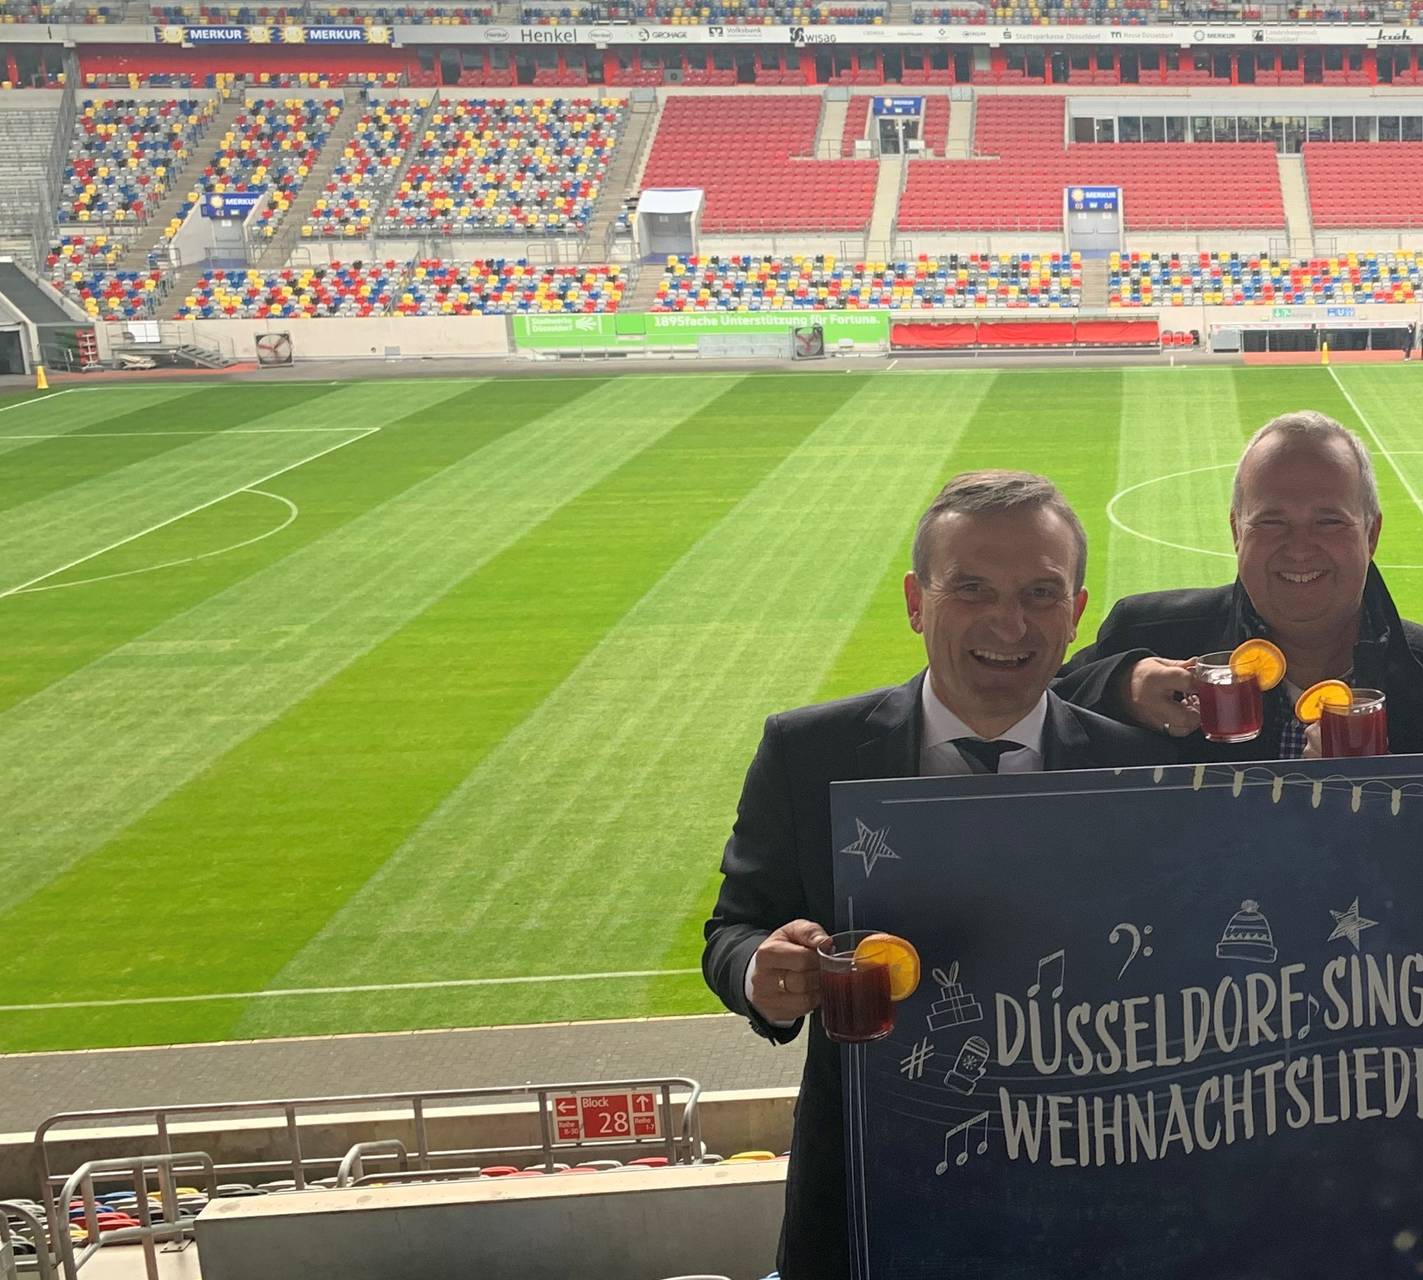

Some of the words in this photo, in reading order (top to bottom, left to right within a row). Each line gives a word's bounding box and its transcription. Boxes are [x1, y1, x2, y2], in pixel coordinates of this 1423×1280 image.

[190, 29, 242, 40] MERKUR
[310, 29, 361, 40] MERKUR
[521, 28, 577, 43] Henkel
[654, 316, 718, 327] 1895fache
[720, 315, 808, 327] Unterstützung
[830, 315, 881, 324] Fortuna.
[996, 962, 1307, 1075] DÜSSELDORF
[582, 1097, 609, 1108] Block
[598, 1112, 628, 1134] 28
